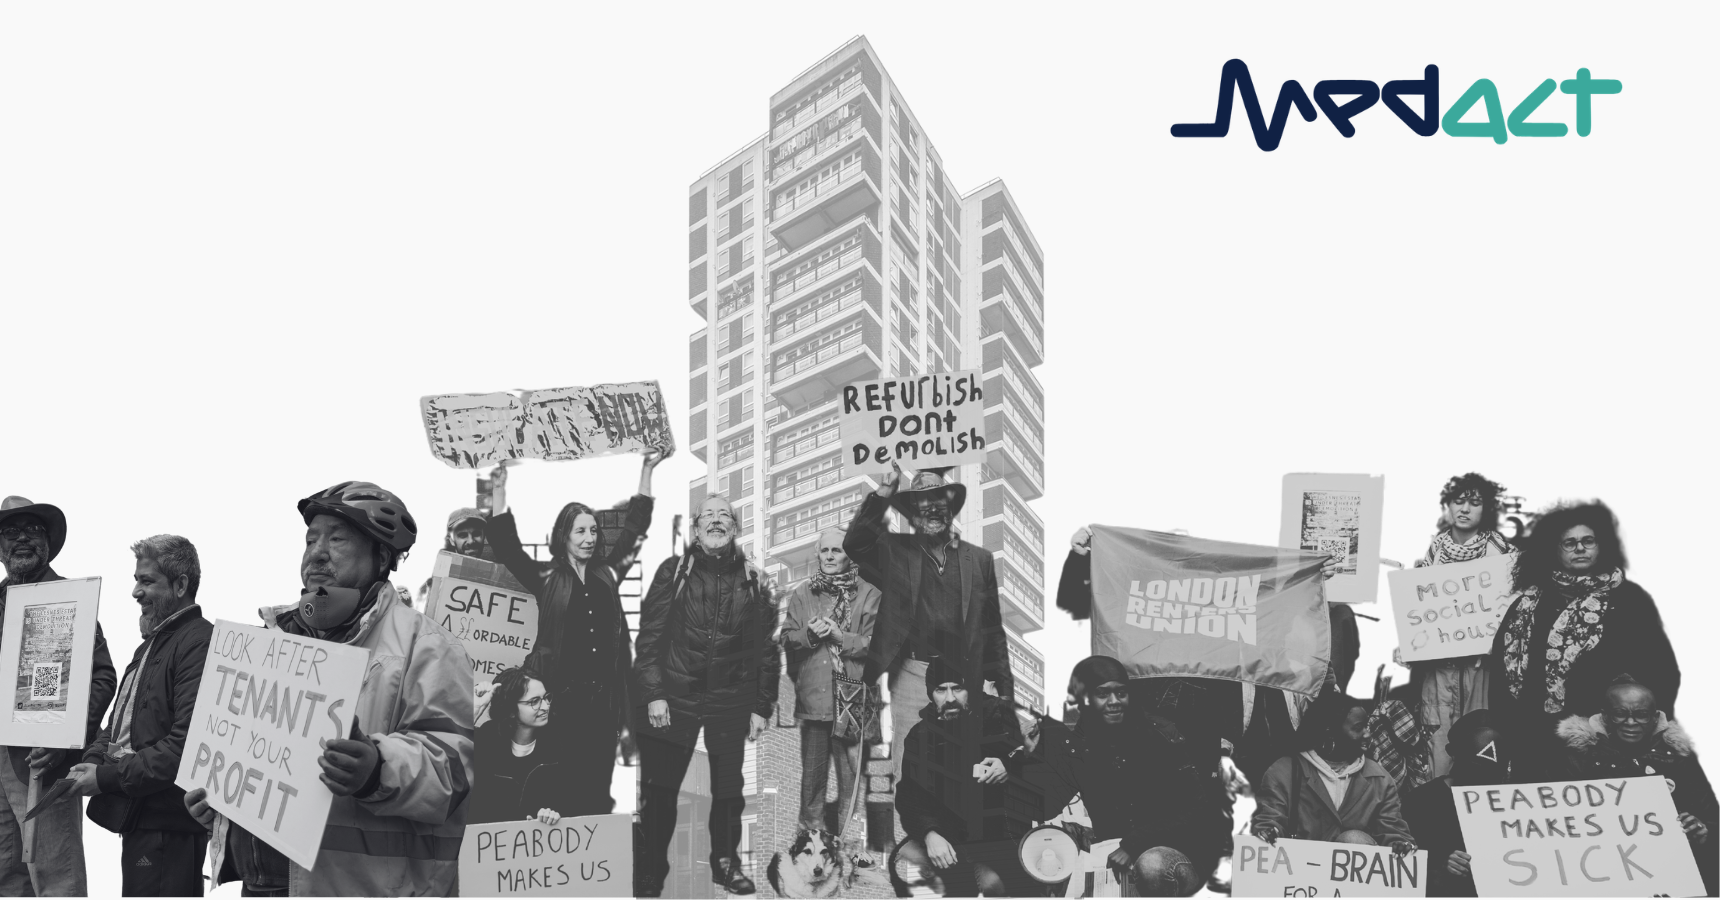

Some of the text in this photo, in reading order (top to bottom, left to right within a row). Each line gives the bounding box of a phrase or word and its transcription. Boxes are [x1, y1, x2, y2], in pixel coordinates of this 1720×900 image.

[598, 391, 664, 440] NOW
[445, 585, 527, 625] SAFE
[1127, 596, 1257, 619] RENTERS
[1129, 574, 1261, 608] LONDON
[1125, 612, 1257, 646] UNION
[213, 628, 328, 686] LOOK AFTER
[216, 664, 345, 750] TENANTS
[206, 713, 292, 776] NOT YOUR
[190, 742, 299, 833] PROFIT
[1463, 780, 1627, 814] PEABODY
[477, 823, 598, 864] PEABODY
[1500, 812, 1664, 839] MAKES US
[497, 860, 611, 893] MAKES US
[1239, 845, 1293, 876] PEA
[1330, 849, 1418, 889] BRAIN
[1502, 843, 1654, 886] SICK
